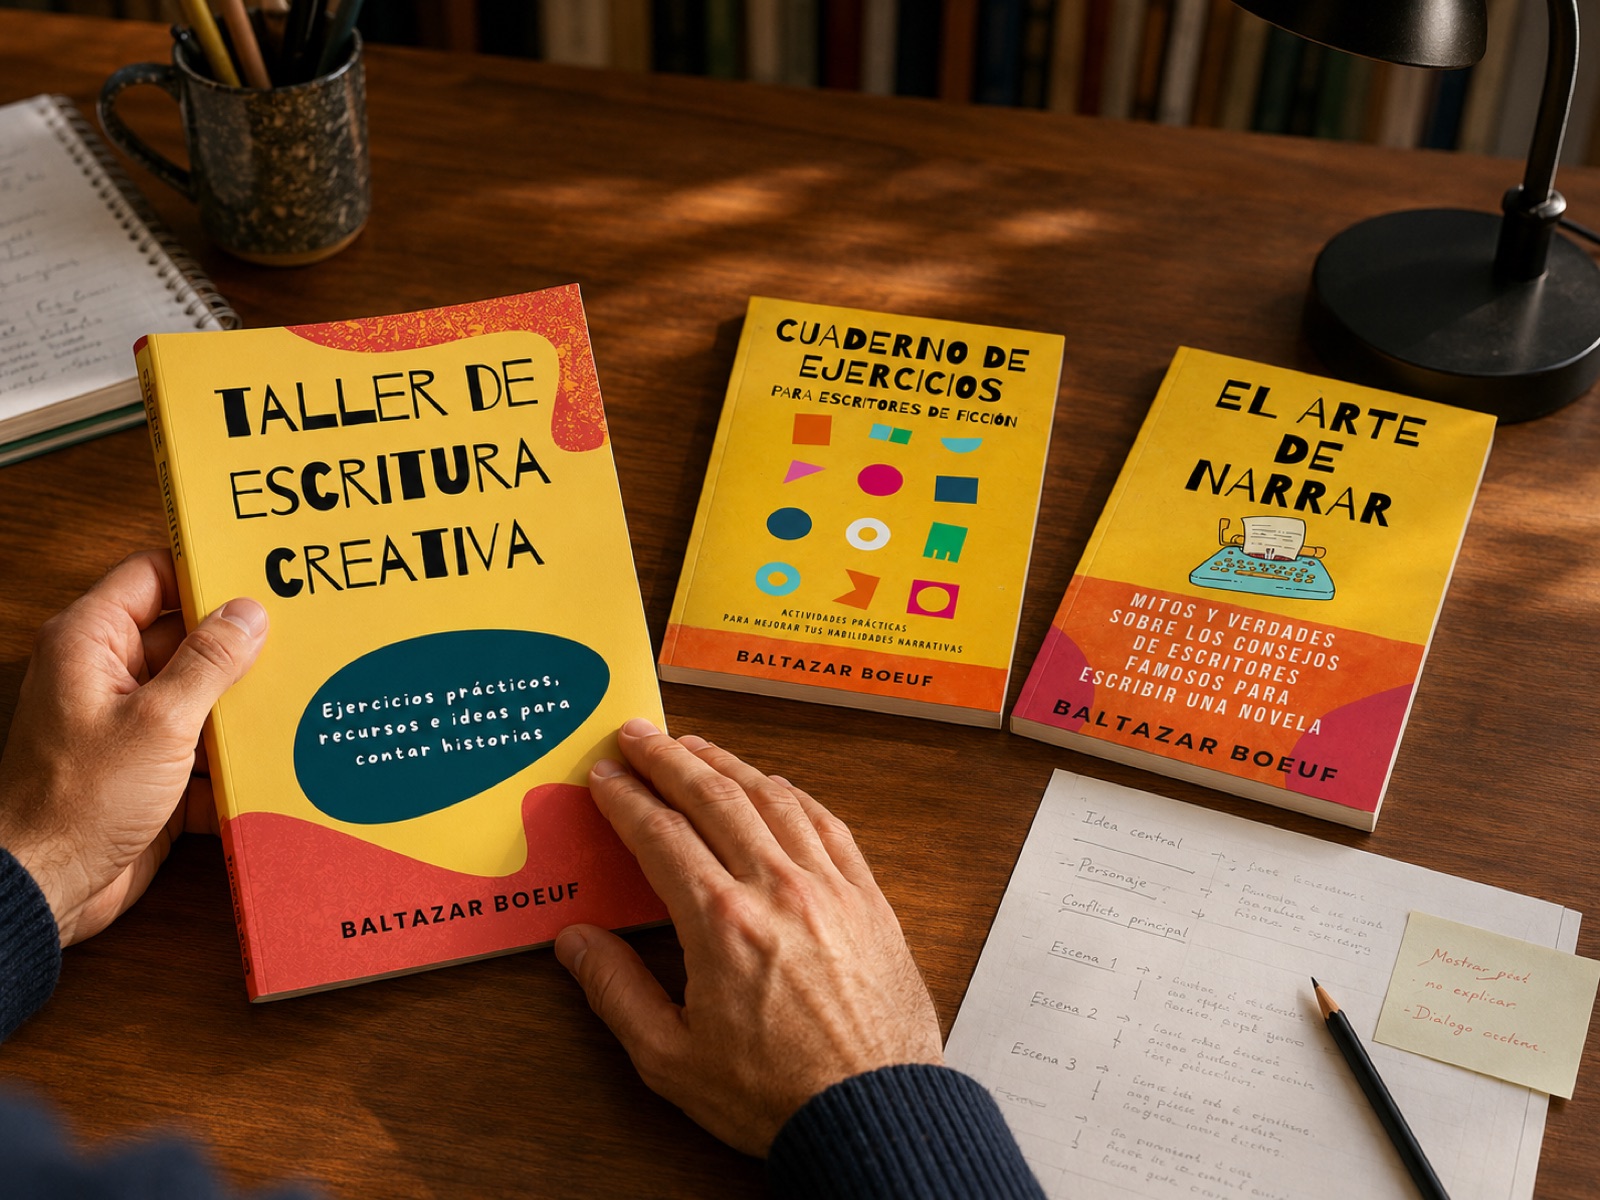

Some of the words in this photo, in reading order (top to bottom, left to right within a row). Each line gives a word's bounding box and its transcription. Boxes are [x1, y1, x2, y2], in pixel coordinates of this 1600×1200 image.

[777, 319, 968, 364] CUADERNO
[983, 346, 1029, 372] DE
[214, 370, 448, 437] TALLER
[465, 359, 538, 411] DE
[800, 355, 1002, 402] EJERCICIOS
[772, 386, 811, 400] PARA
[819, 392, 920, 414] ESCRITORES
[928, 407, 949, 418] DE
[957, 410, 1017, 427] FICCIÓN
[1216, 380, 1276, 418] EL
[1297, 398, 1426, 447] ARTE
[1274, 434, 1343, 473] DE
[230, 438, 551, 519] ESCRITURA
[1186, 459, 1391, 527] NARRAR
[266, 520, 544, 597] CREATIVA
[723, 613, 749, 624] PARA
[755, 619, 799, 631] MEJORAR
[806, 626, 822, 634] TUS
[828, 629, 893, 644] HABILIDADES
[899, 639, 961, 652] NARRATIVAS
[782, 610, 845, 623] ACTIVIDADES
[852, 618, 907, 633] PRÁCTICAS
[1110, 610, 1177, 635] SOBRE
[1186, 625, 1224, 645] LOS
[1234, 637, 1339, 670] CONSEJOS
[1130, 593, 1196, 618] MITOS
[1208, 608, 1218, 622] Y
[1228, 613, 1335, 647] VERDADES
[737, 651, 851, 676] BALTAZAR
[862, 668, 932, 686] BOEUF
[1125, 656, 1224, 690] FAMOSOS
[1234, 680, 1288, 705] PARA
[1133, 635, 1159, 653] DE
[1168, 643, 1299, 684] ESCRITORES
[323, 693, 433, 719] Ejercicios
[447, 676, 559, 705] prácticos,
[1079, 667, 1176, 703] ESCRIBIR
[1187, 692, 1227, 715] UNA
[1238, 704, 1321, 735] NOVELA
[320, 721, 418, 744] recursos
[431, 718, 439, 727] e
[453, 708, 508, 725] ideas
[522, 700, 569, 720] para
[1053, 699, 1217, 754] BALTAZAR
[1231, 745, 1337, 781] BOEUF
[356, 746, 430, 765] contar
[442, 729, 542, 752] historias
[1082, 810, 1119, 832] Idea
[1129, 829, 1183, 849] central
[1078, 857, 1147, 891] Personaje
[342, 900, 482, 938] BALTAZAR
[494, 882, 579, 912] BOEUF
[1062, 893, 1119, 919] Conflicto
[1128, 915, 1188, 938] principal
[1051, 940, 1099, 963] Escena
[1110, 957, 1118, 969] 1
[1430, 948, 1490, 973] Mostrar
[1031, 991, 1080, 1014] Escena
[1086, 1007, 1098, 1020] 2
[1425, 980, 1443, 990] no
[1011, 1042, 1059, 1065] Escena
[1065, 1058, 1077, 1071] 3
